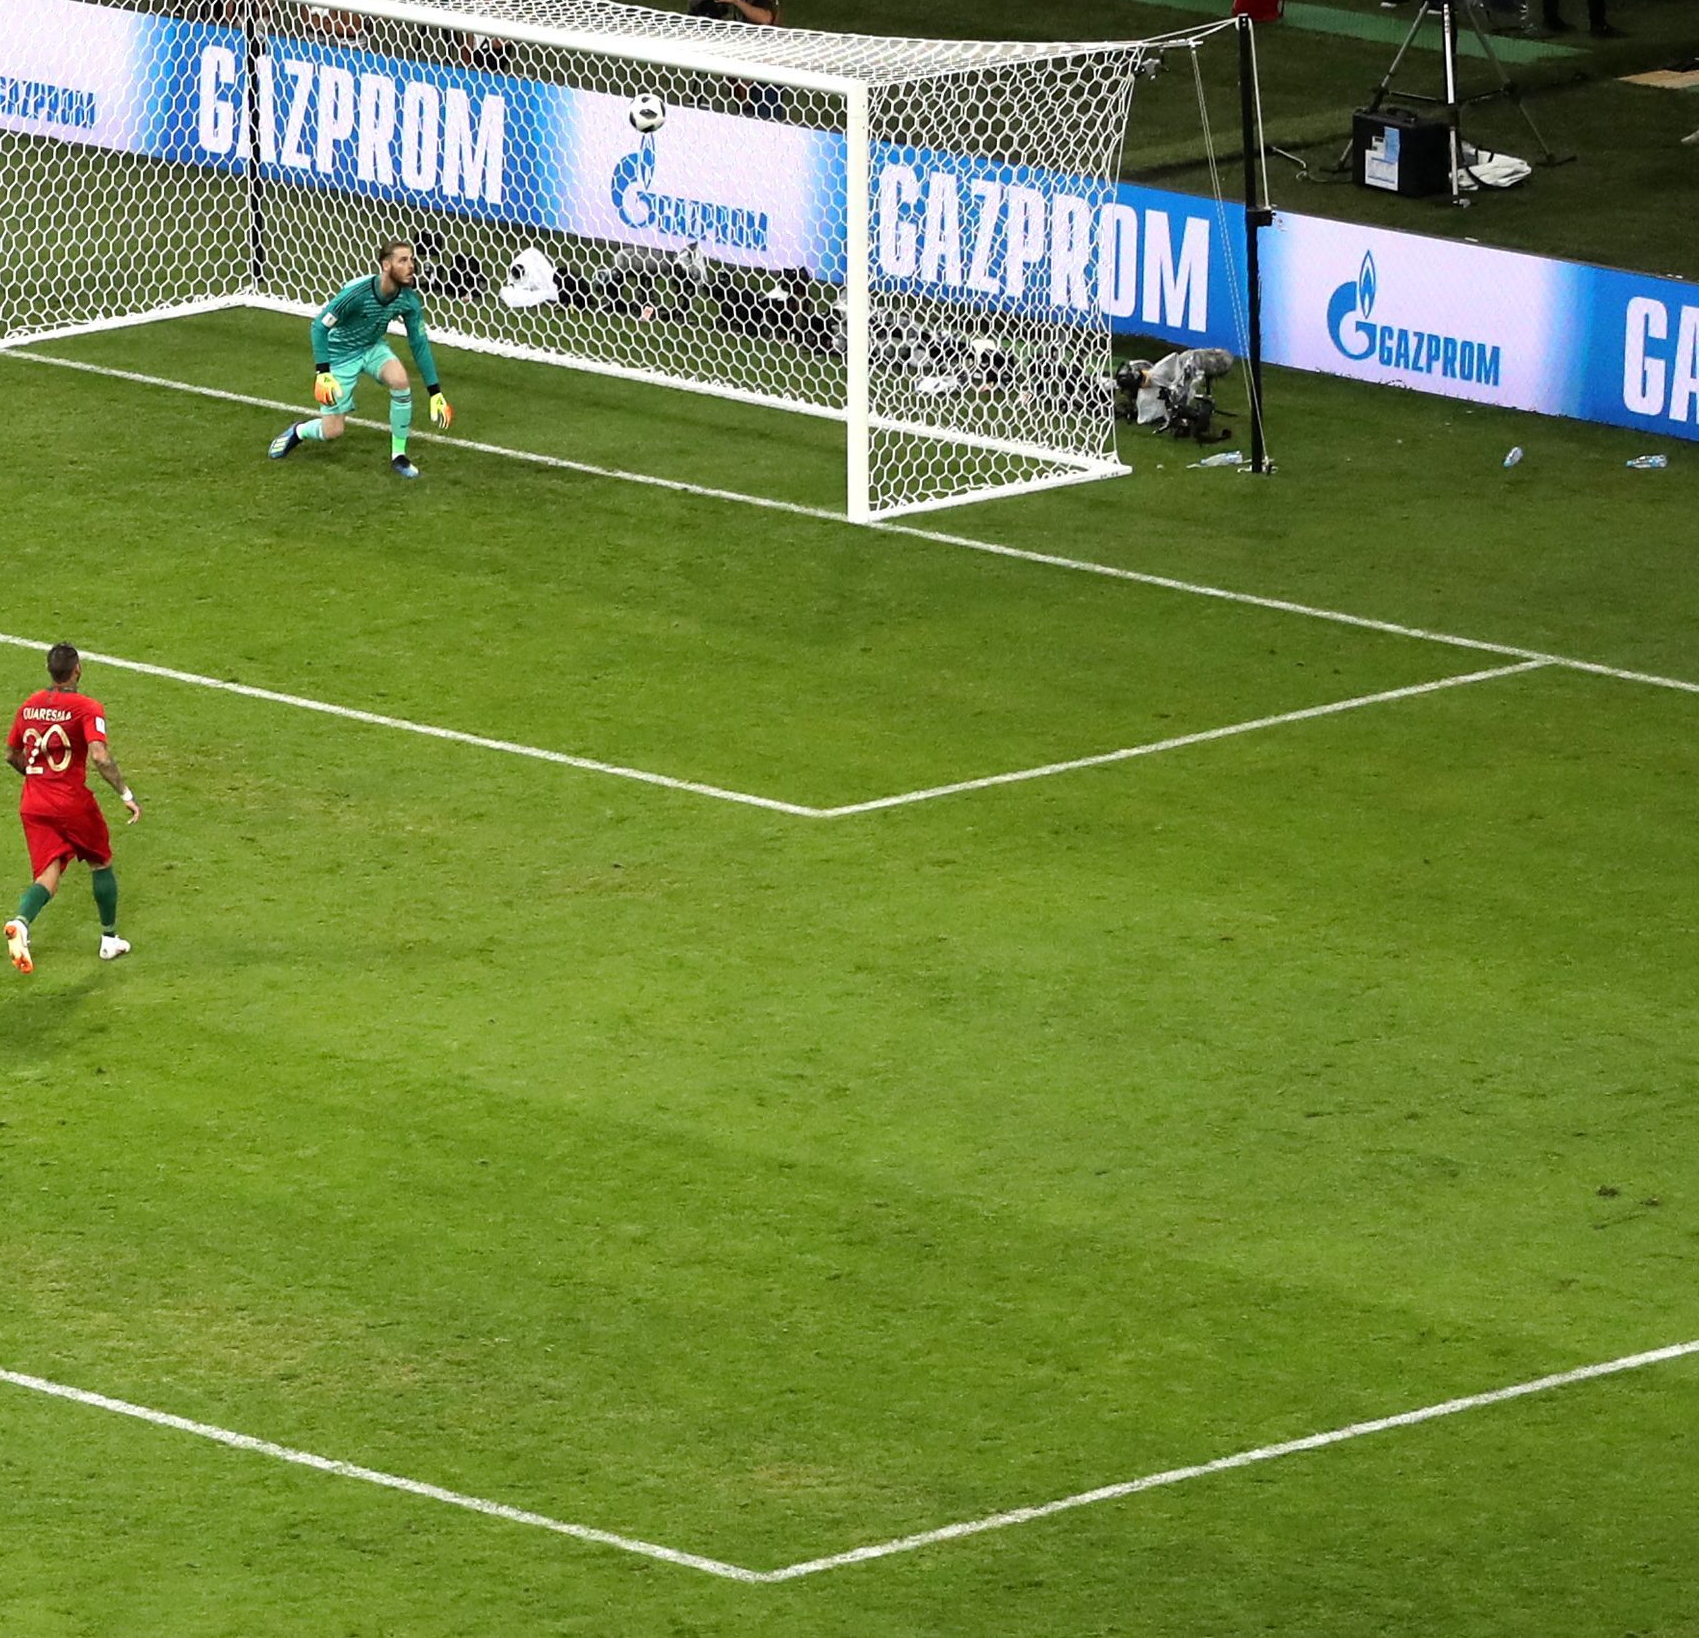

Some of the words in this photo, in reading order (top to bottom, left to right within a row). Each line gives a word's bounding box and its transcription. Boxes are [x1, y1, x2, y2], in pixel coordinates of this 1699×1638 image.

[200, 45, 505, 204] GAZPROM
[658, 193, 768, 251] GAZPROM
[880, 162, 1210, 332] GAZPROM
[1379, 320, 1501, 387] GAZPROM
[23, 723, 72, 774] 20
